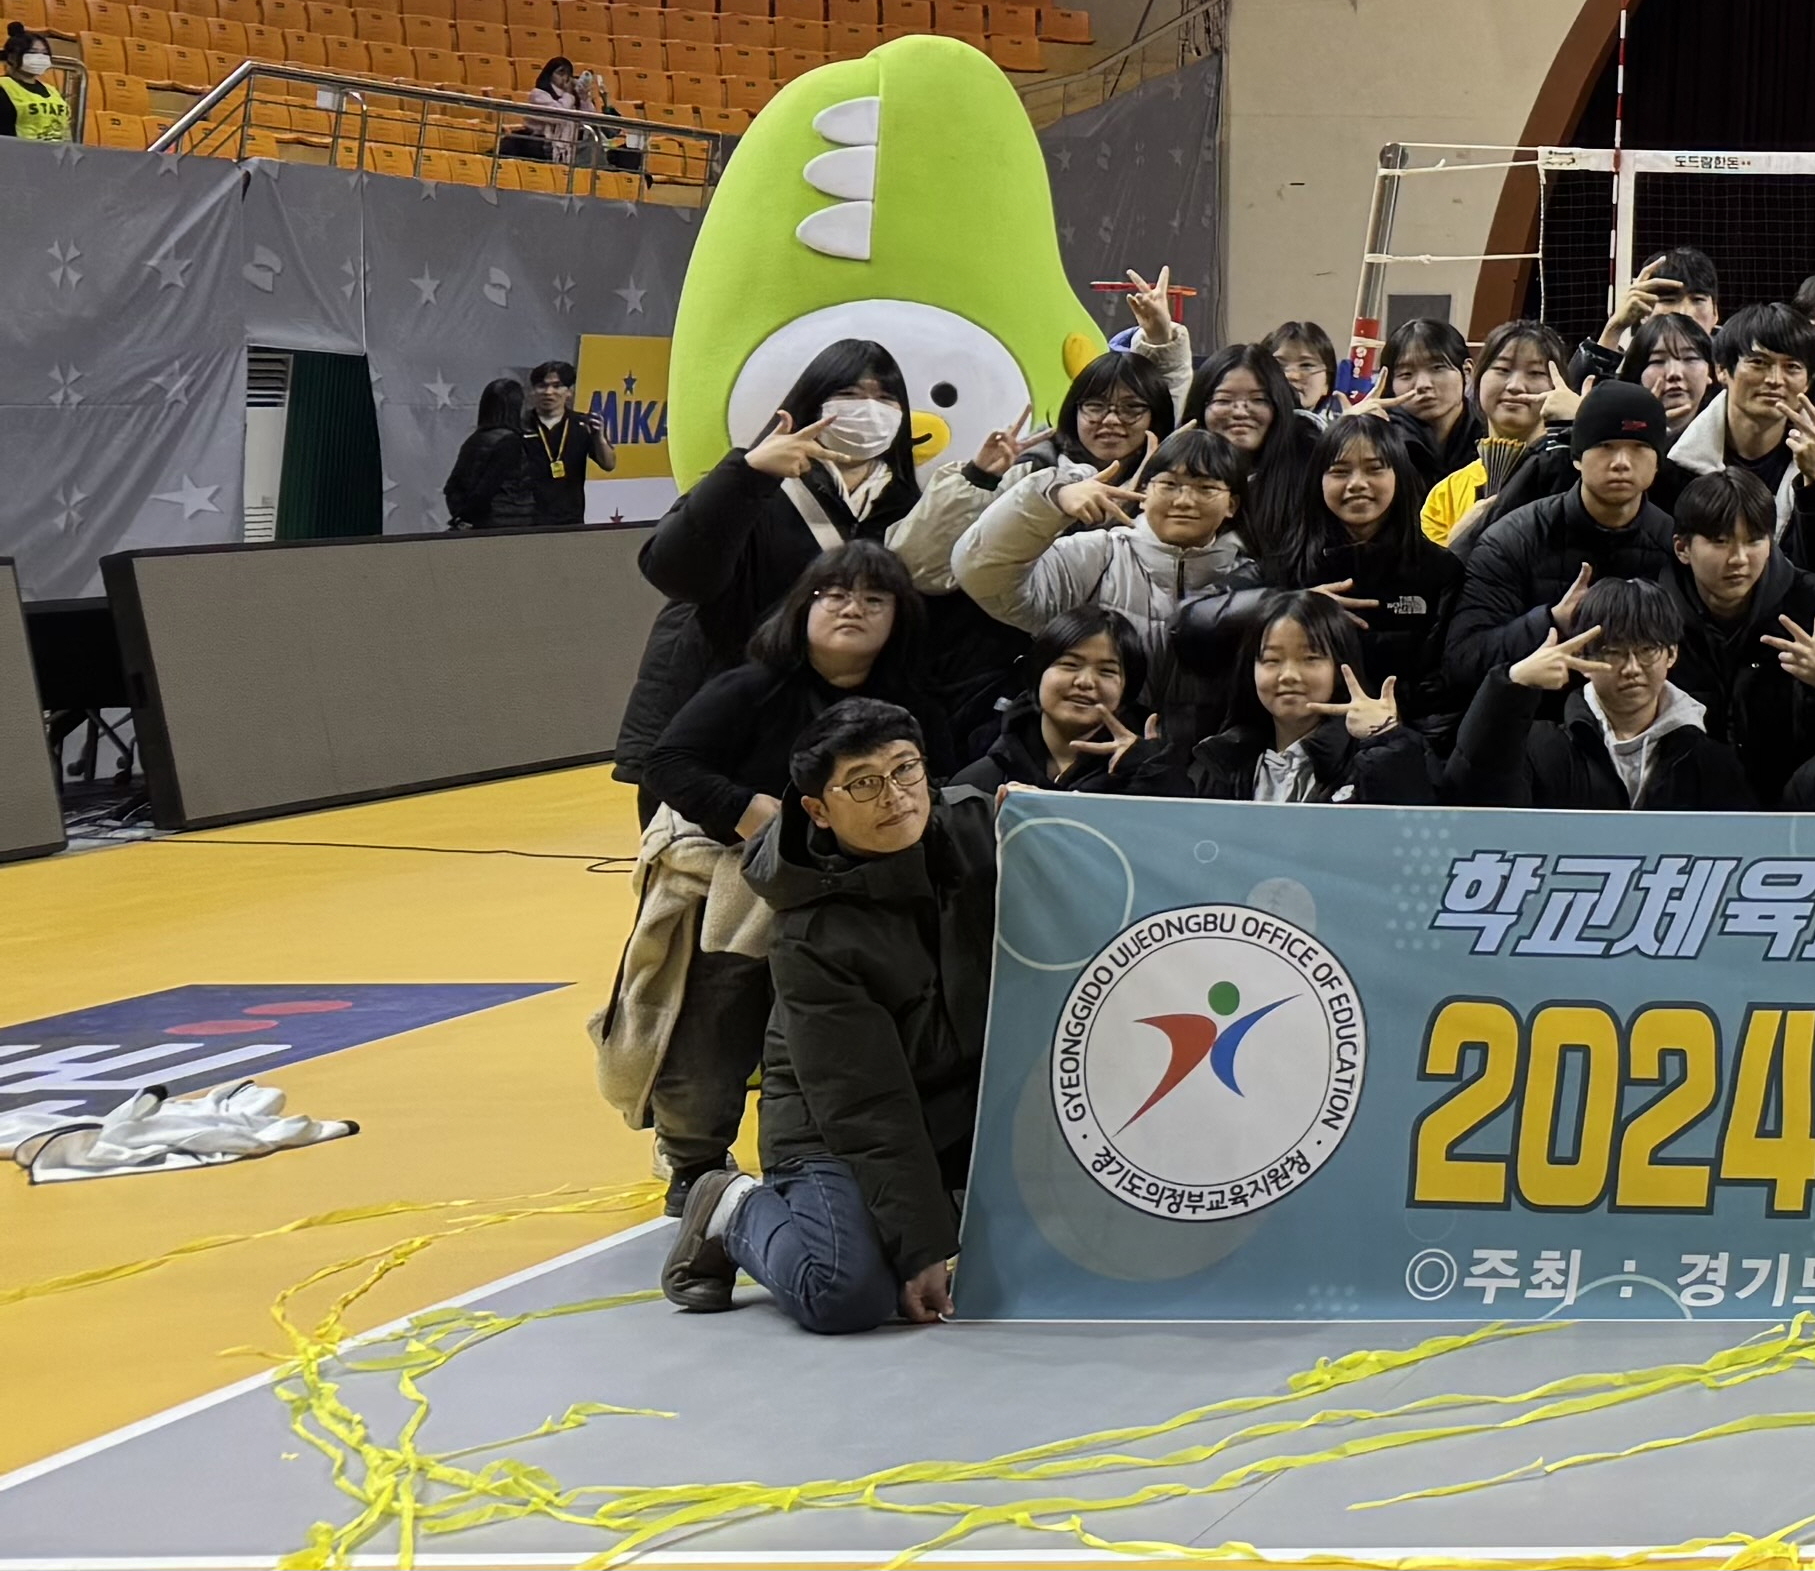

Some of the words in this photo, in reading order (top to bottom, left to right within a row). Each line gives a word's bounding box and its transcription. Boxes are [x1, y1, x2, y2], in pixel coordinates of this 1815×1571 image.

[1675, 155, 1739, 170] 도드람한돈
[1109, 913, 1237, 970] UIJEONGBU
[1241, 917, 1319, 968] OFFICE
[1311, 962, 1343, 991] OF
[1059, 964, 1114, 1123] GYEONGGIDO
[1321, 992, 1357, 1131] EDUCATION
[1091, 1145, 1311, 1214] 경기도의정부교육지원청
[1463, 1248, 1580, 1308] 주최
